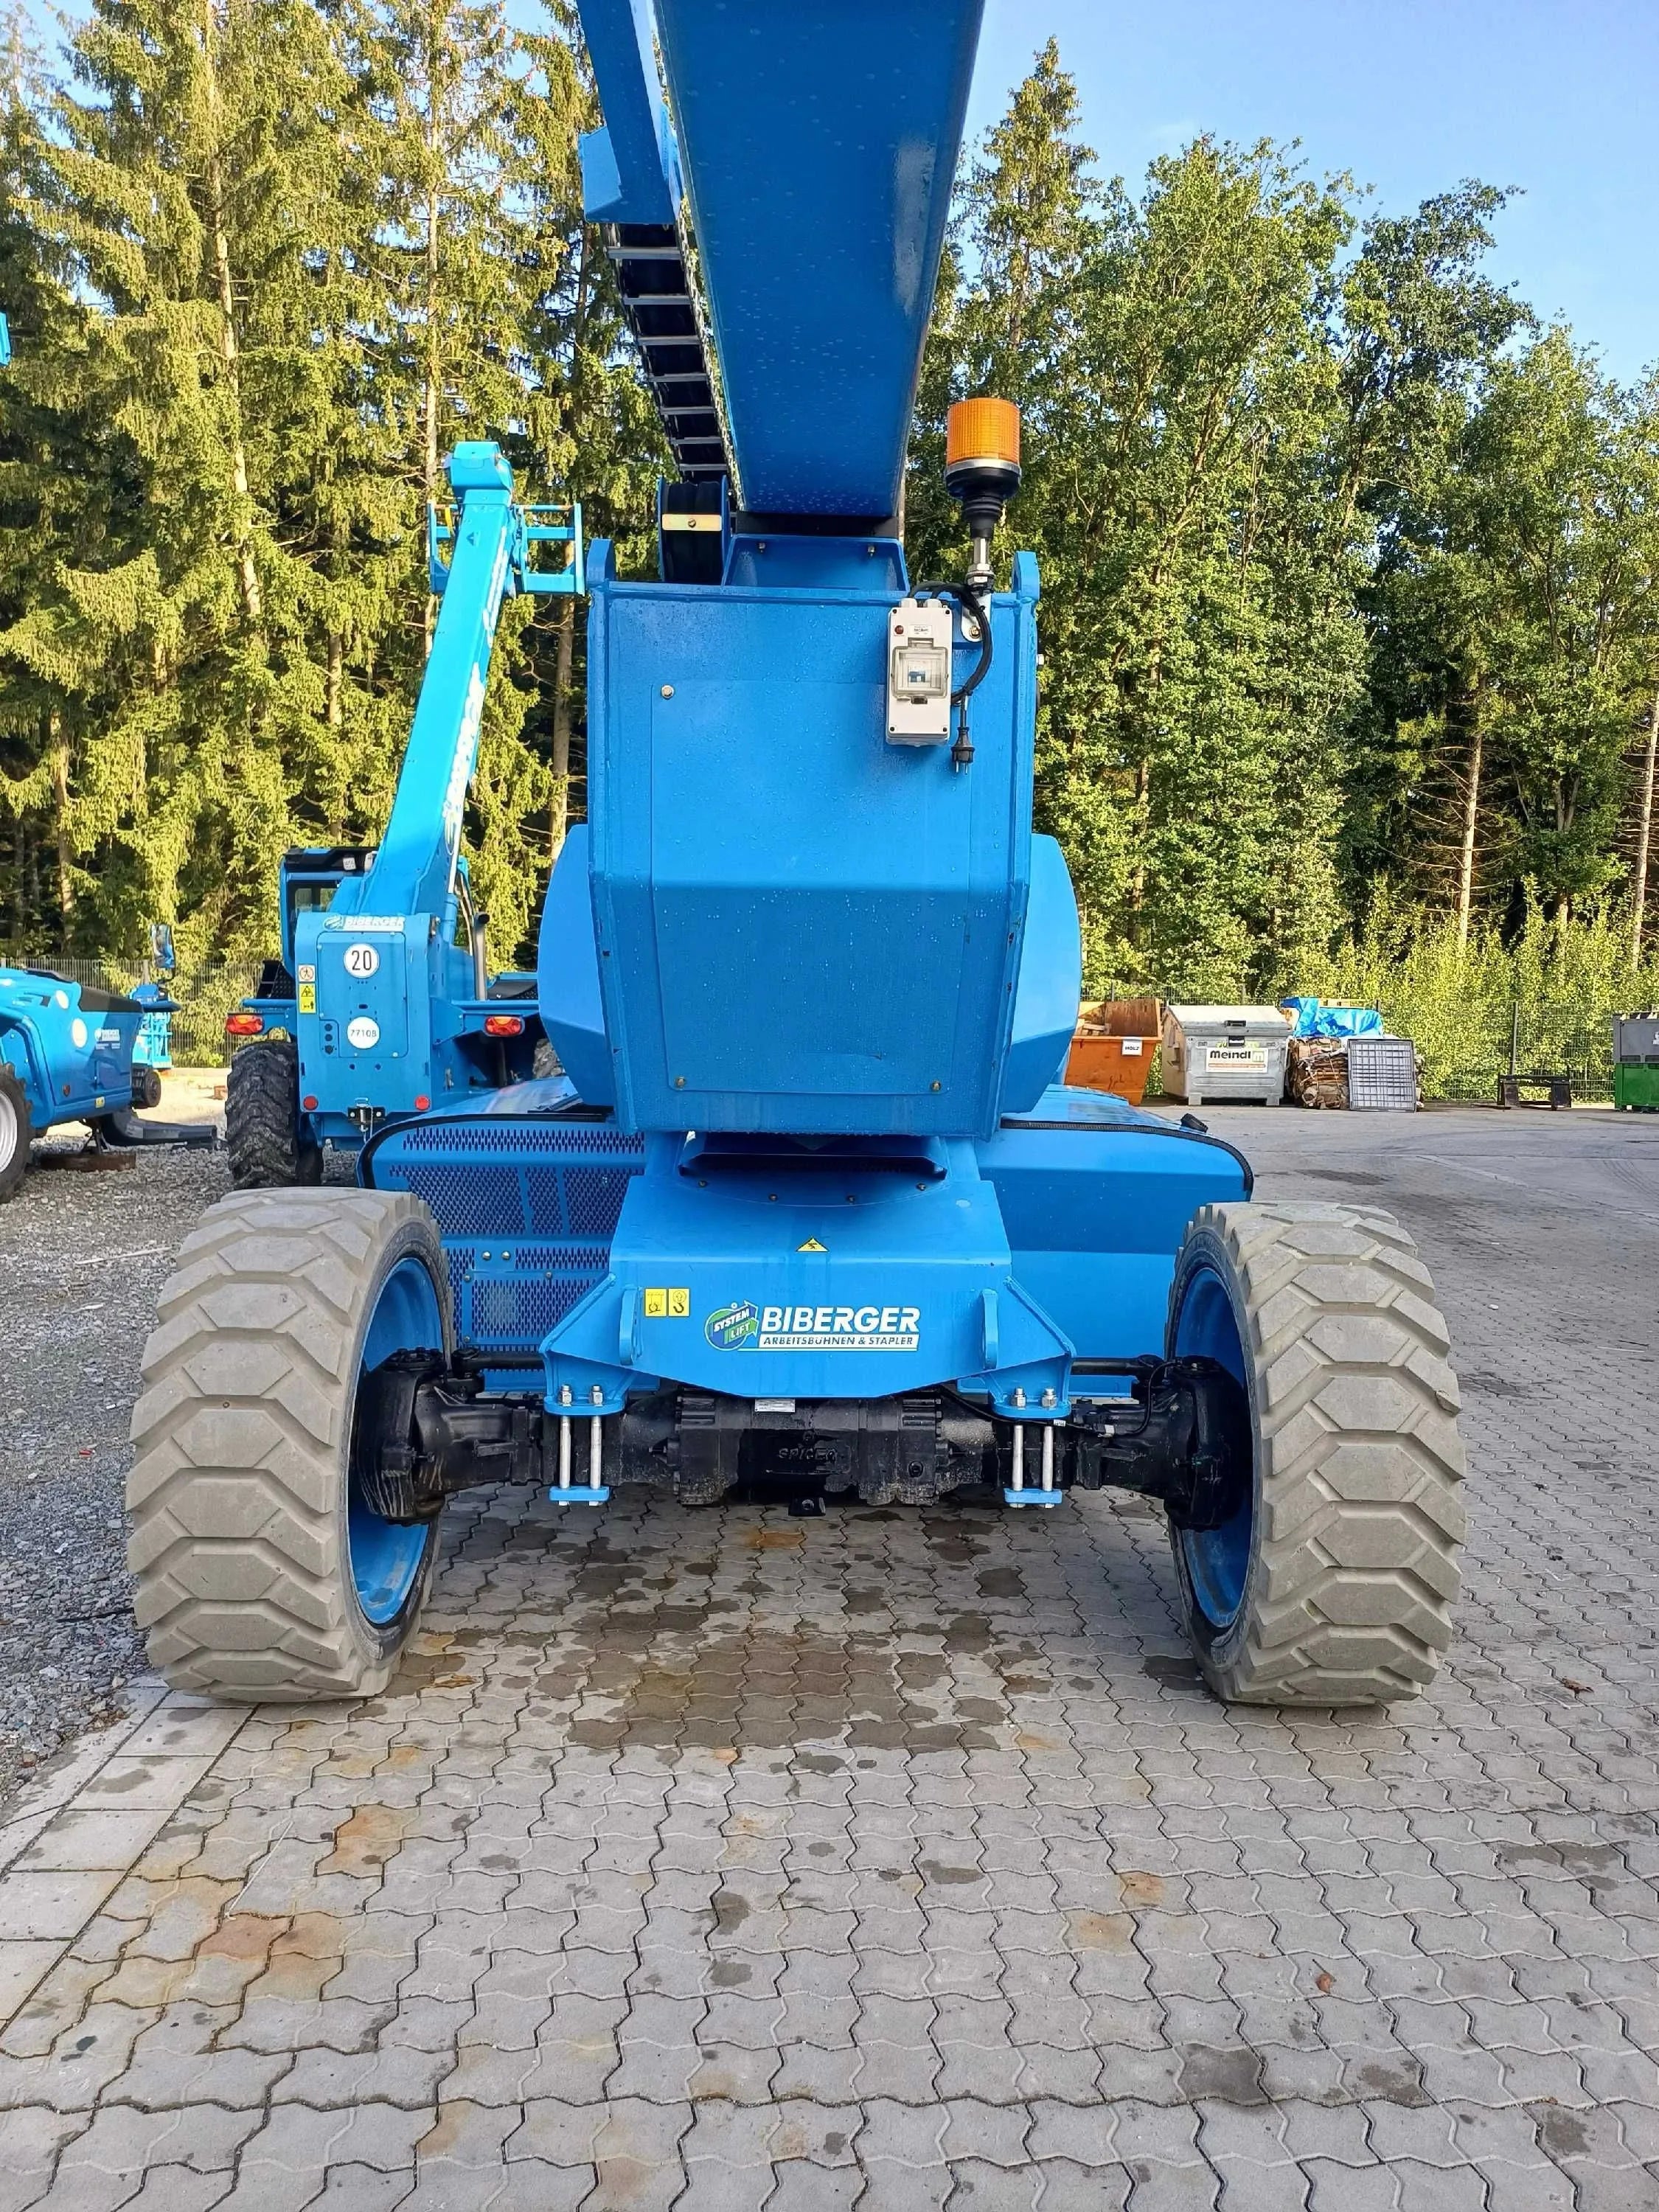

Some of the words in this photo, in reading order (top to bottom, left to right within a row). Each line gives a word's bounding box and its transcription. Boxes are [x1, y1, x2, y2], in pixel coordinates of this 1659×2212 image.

[352, 950, 372, 971] 20
[714, 1308, 750, 1332] SYSTEM
[761, 1307, 920, 1332] BIBERGER
[731, 1322, 751, 1339] LIFT
[763, 1337, 855, 1345] ARBEITSBÜHNEN
[858, 1337, 866, 1345] &
[869, 1337, 914, 1345] STAPLER
